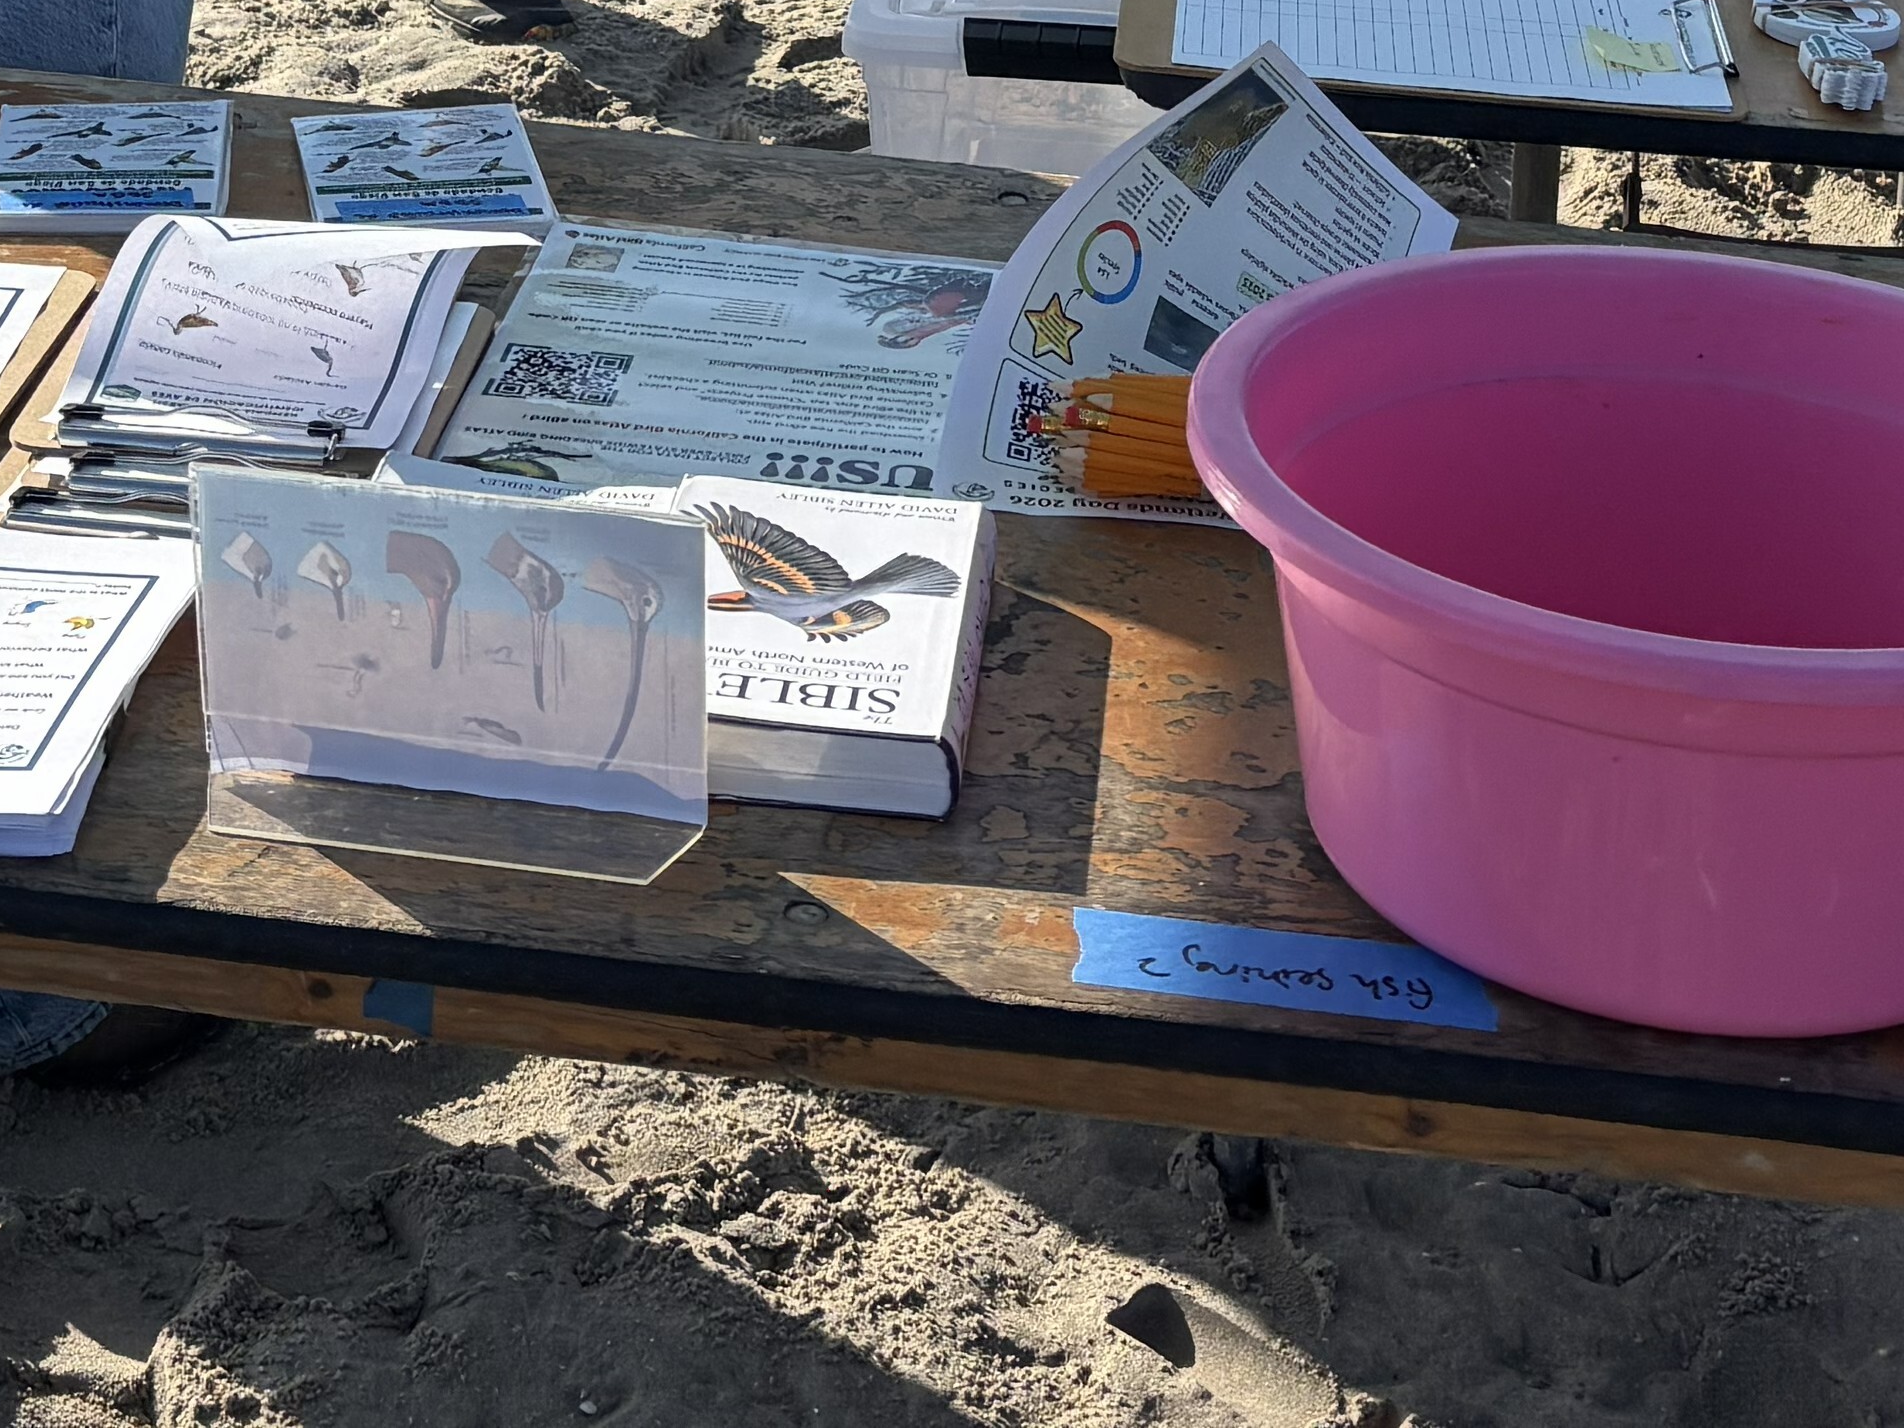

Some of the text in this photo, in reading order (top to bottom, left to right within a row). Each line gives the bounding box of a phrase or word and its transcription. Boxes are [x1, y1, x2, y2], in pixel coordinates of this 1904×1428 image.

[151, 390, 182, 399] AVES
[464, 426, 505, 436] ATLAS
[594, 420, 631, 430] Atlas
[634, 424, 663, 434] Bird
[668, 427, 738, 440] California
[742, 434, 767, 443] the
[770, 437, 784, 446] in
[787, 438, 868, 452] participate
[871, 447, 887, 455] to
[890, 449, 924, 458] How
[759, 452, 934, 492] US!!!
[597, 487, 656, 503] DAVID
[1010, 495, 1064, 508] 2026
[776, 492, 958, 515] DAVID ALLEN SIBLEY
[1073, 498, 1119, 511] Day
[751, 649, 805, 664] North
[812, 655, 884, 671] Western
[738, 660, 767, 671] TO
[773, 664, 838, 680] GUIDE
[890, 662, 909, 673] of
[844, 670, 903, 685] FIELD
[708, 672, 901, 714] SIBLE
[862, 714, 893, 726] The
[1181, 943, 1334, 992] seining
[1349, 972, 1434, 1011] fish
